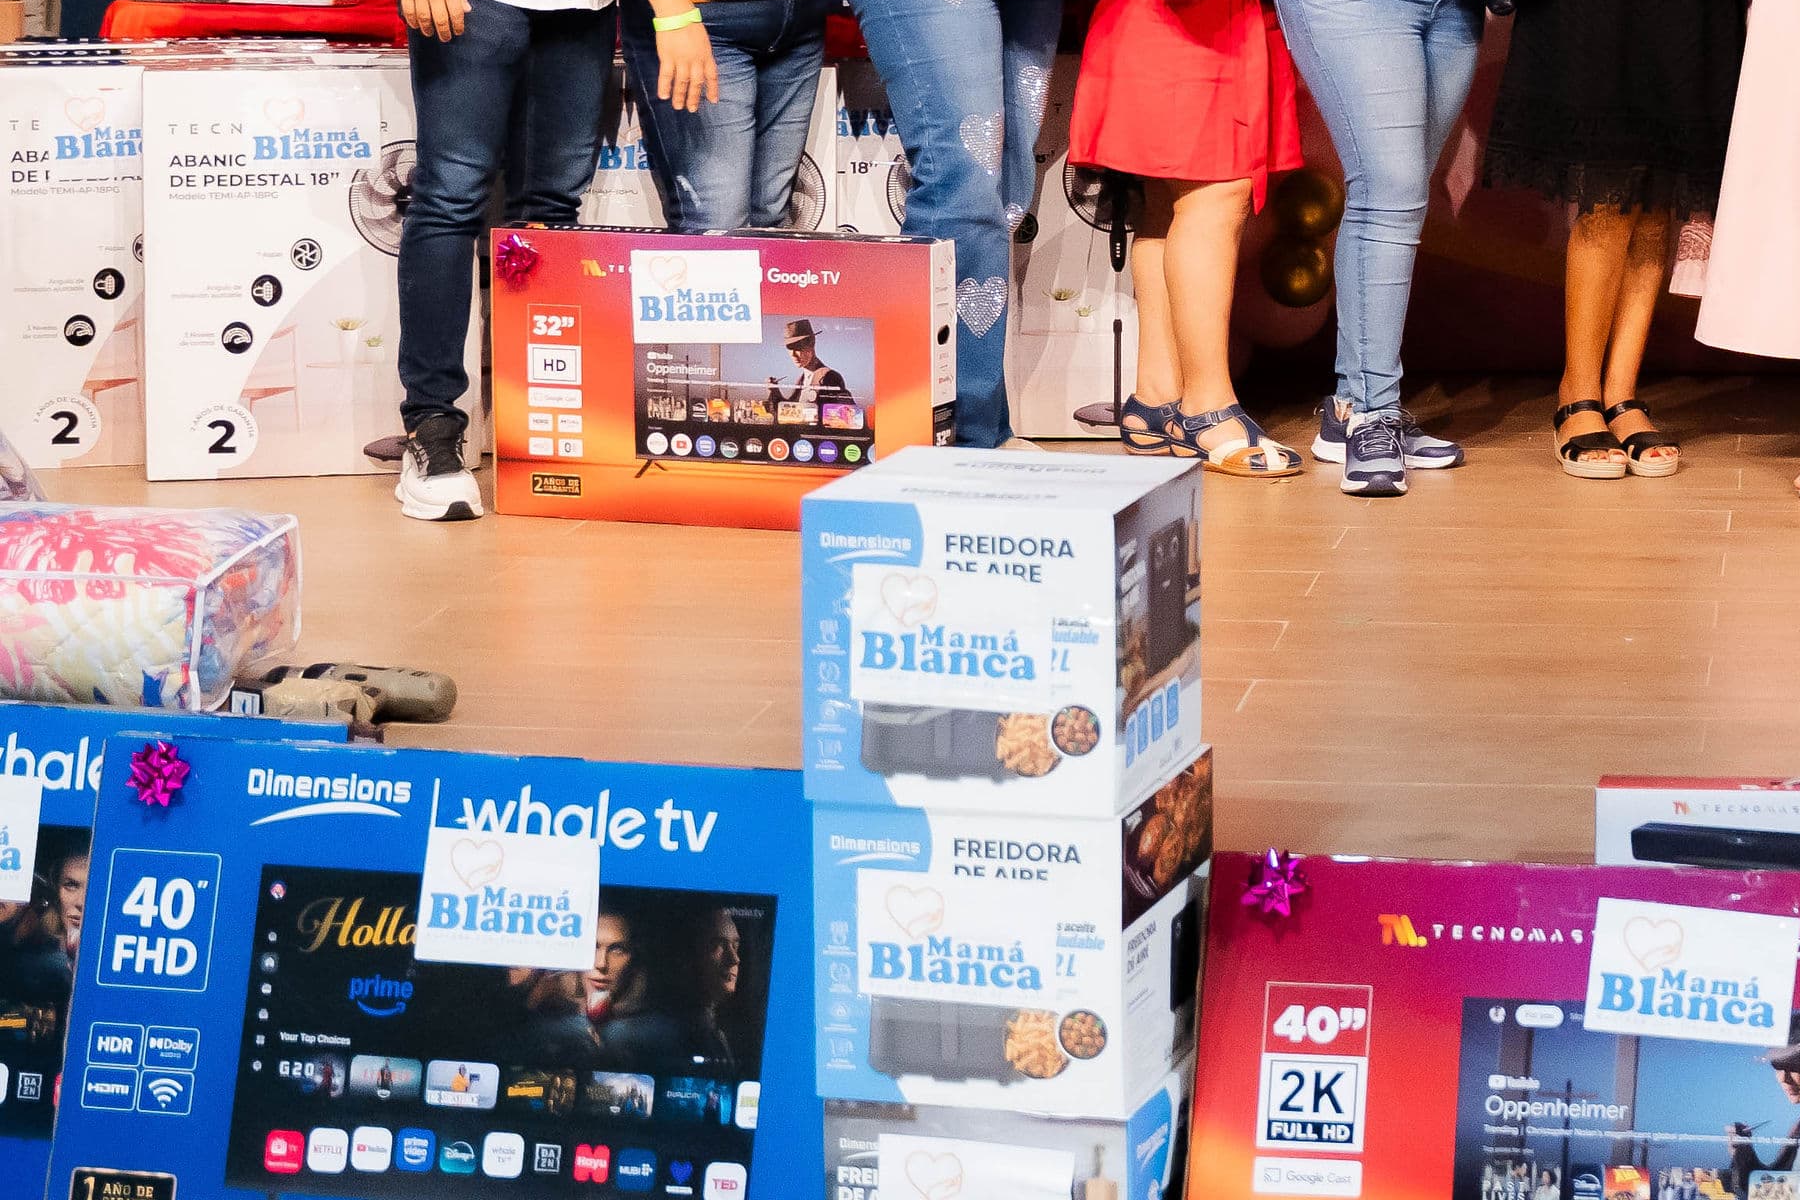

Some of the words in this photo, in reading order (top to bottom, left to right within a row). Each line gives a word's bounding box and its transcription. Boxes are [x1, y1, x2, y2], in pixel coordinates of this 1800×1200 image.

[94, 126, 142, 140] Mam
[292, 128, 360, 142] Mamá
[54, 133, 143, 160] Blan
[253, 135, 372, 160] Blanca
[598, 145, 649, 170] Bla
[170, 154, 247, 168] ABANIC
[11, 170, 38, 183] DE
[169, 174, 197, 187] DE
[203, 173, 306, 187] PEDESTAL
[767, 267, 818, 288] Google
[821, 271, 840, 285] TV
[677, 288, 739, 303] Mamá
[639, 296, 751, 322] Blanca
[544, 359, 566, 372] HD
[647, 362, 717, 376] Oppenheimer
[50, 411, 80, 445] 2
[207, 420, 237, 454] 2
[534, 477, 543, 491] 2
[820, 531, 912, 552] Dimensions
[945, 534, 1074, 558] FREIDORA
[920, 624, 1020, 653] Mamá
[860, 631, 1036, 681] Blanca
[0, 732, 103, 791] hal
[248, 768, 412, 804] Dimensions
[454, 785, 646, 850] whale
[655, 798, 718, 852] tv
[830, 835, 921, 855] Dimensions
[954, 838, 1081, 864] FREIDORA
[482, 885, 570, 911] Mamá
[298, 896, 416, 953] Holla
[427, 893, 582, 938] Blanca
[1064, 922, 1096, 934] aceite
[1433, 924, 1583, 943] TECNOMAS
[927, 935, 1025, 963] Mamá
[1056, 935, 1105, 950] udable
[110, 935, 198, 976] FHD
[868, 942, 1042, 991] Blanca
[349, 974, 414, 999] prime
[1660, 968, 1759, 999] Mamá
[1599, 973, 1775, 1029] Blanca
[97, 1036, 133, 1053] HDR
[164, 1038, 193, 1053] Dolby
[280, 1031, 299, 1042] Your
[300, 1033, 316, 1044] Top
[317, 1034, 351, 1046] Choices
[1279, 1069, 1345, 1113] 2K
[1485, 1095, 1629, 1120] Oppenheimer
[1270, 1122, 1318, 1140] FULL
[1322, 1124, 1350, 1142] HD
[313, 1144, 343, 1155] NETFLIX
[619, 1165, 641, 1176] MUBI
[838, 1166, 879, 1185] FREI
[1286, 1171, 1324, 1185] Google
[1327, 1172, 1353, 1184] Cast
[83, 1176, 95, 1200] 1
[103, 1182, 131, 1197] AÑO
[137, 1186, 154, 1198] DE
[713, 1178, 738, 1190] TED
[838, 1186, 864, 1200] DE
